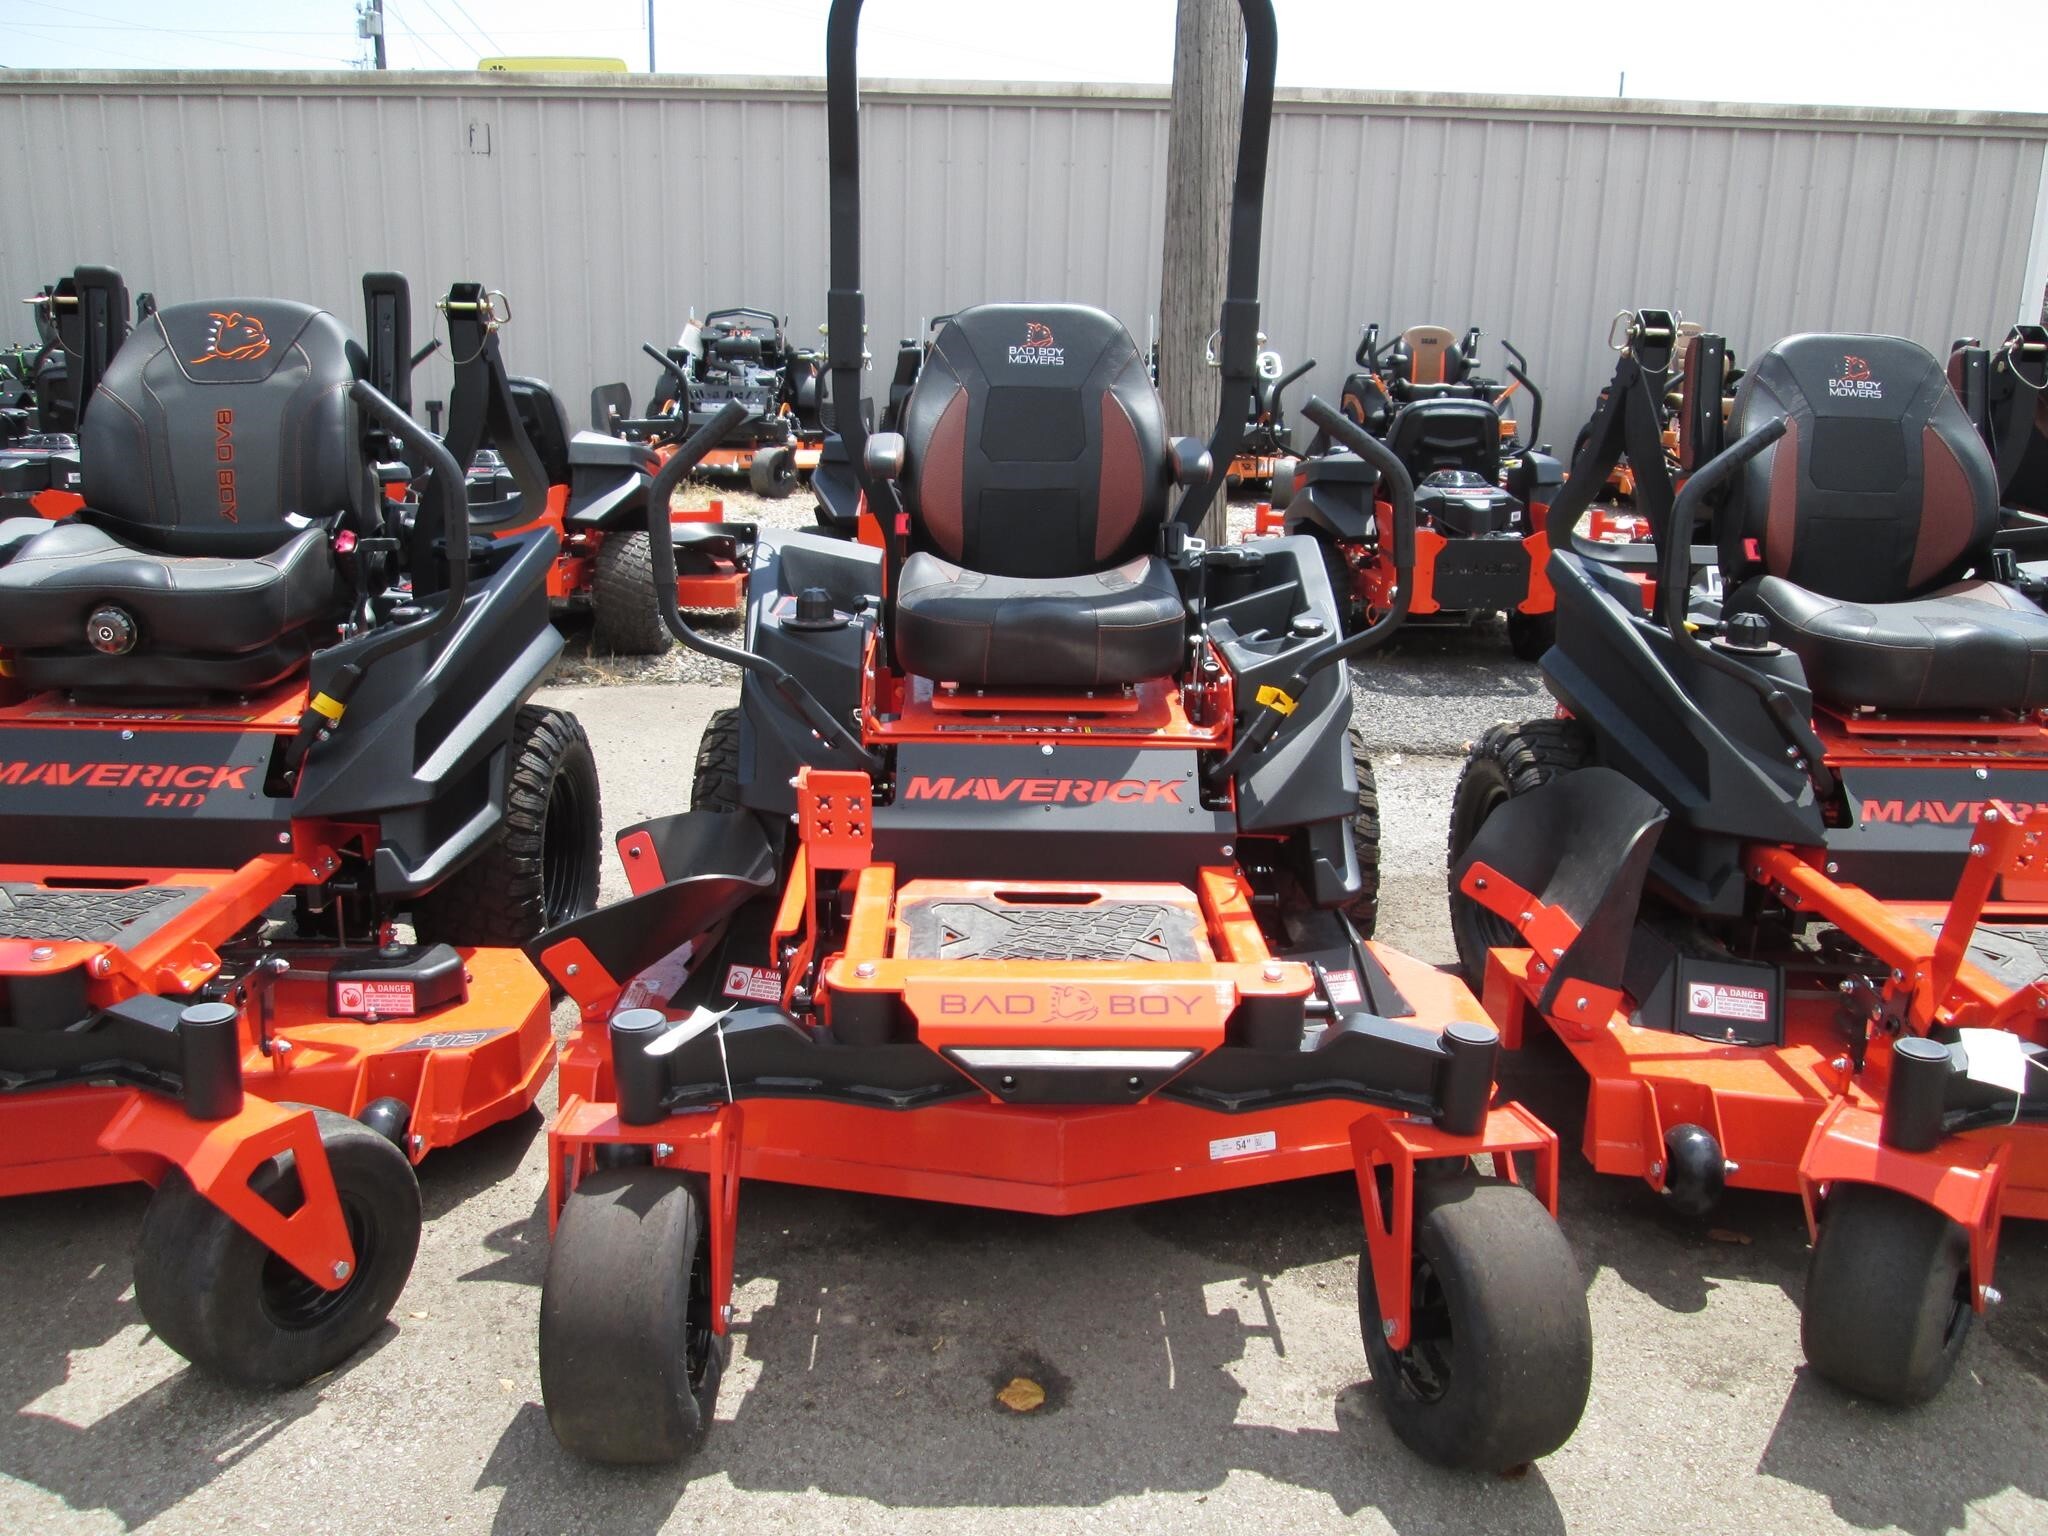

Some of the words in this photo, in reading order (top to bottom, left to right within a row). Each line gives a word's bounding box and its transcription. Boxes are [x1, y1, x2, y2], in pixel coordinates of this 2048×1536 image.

[1008, 346, 1035, 355] BAD
[1038, 347, 1065, 356] BOY
[1008, 354, 1065, 366] MOWERS
[1828, 379, 1854, 388] BAD
[1856, 380, 1882, 389] BOY
[1829, 387, 1882, 399] MOWERS
[216, 408, 233, 462] BAD
[217, 469, 239, 523] BOY
[0, 761, 255, 789] MAVERICK
[904, 775, 1187, 804] MAVERICK
[145, 792, 206, 807] HD
[377, 984, 411, 993] DANGER
[1729, 988, 1764, 1000] DANGER
[940, 994, 1035, 1015] BAD
[1109, 995, 1202, 1015] BOY
